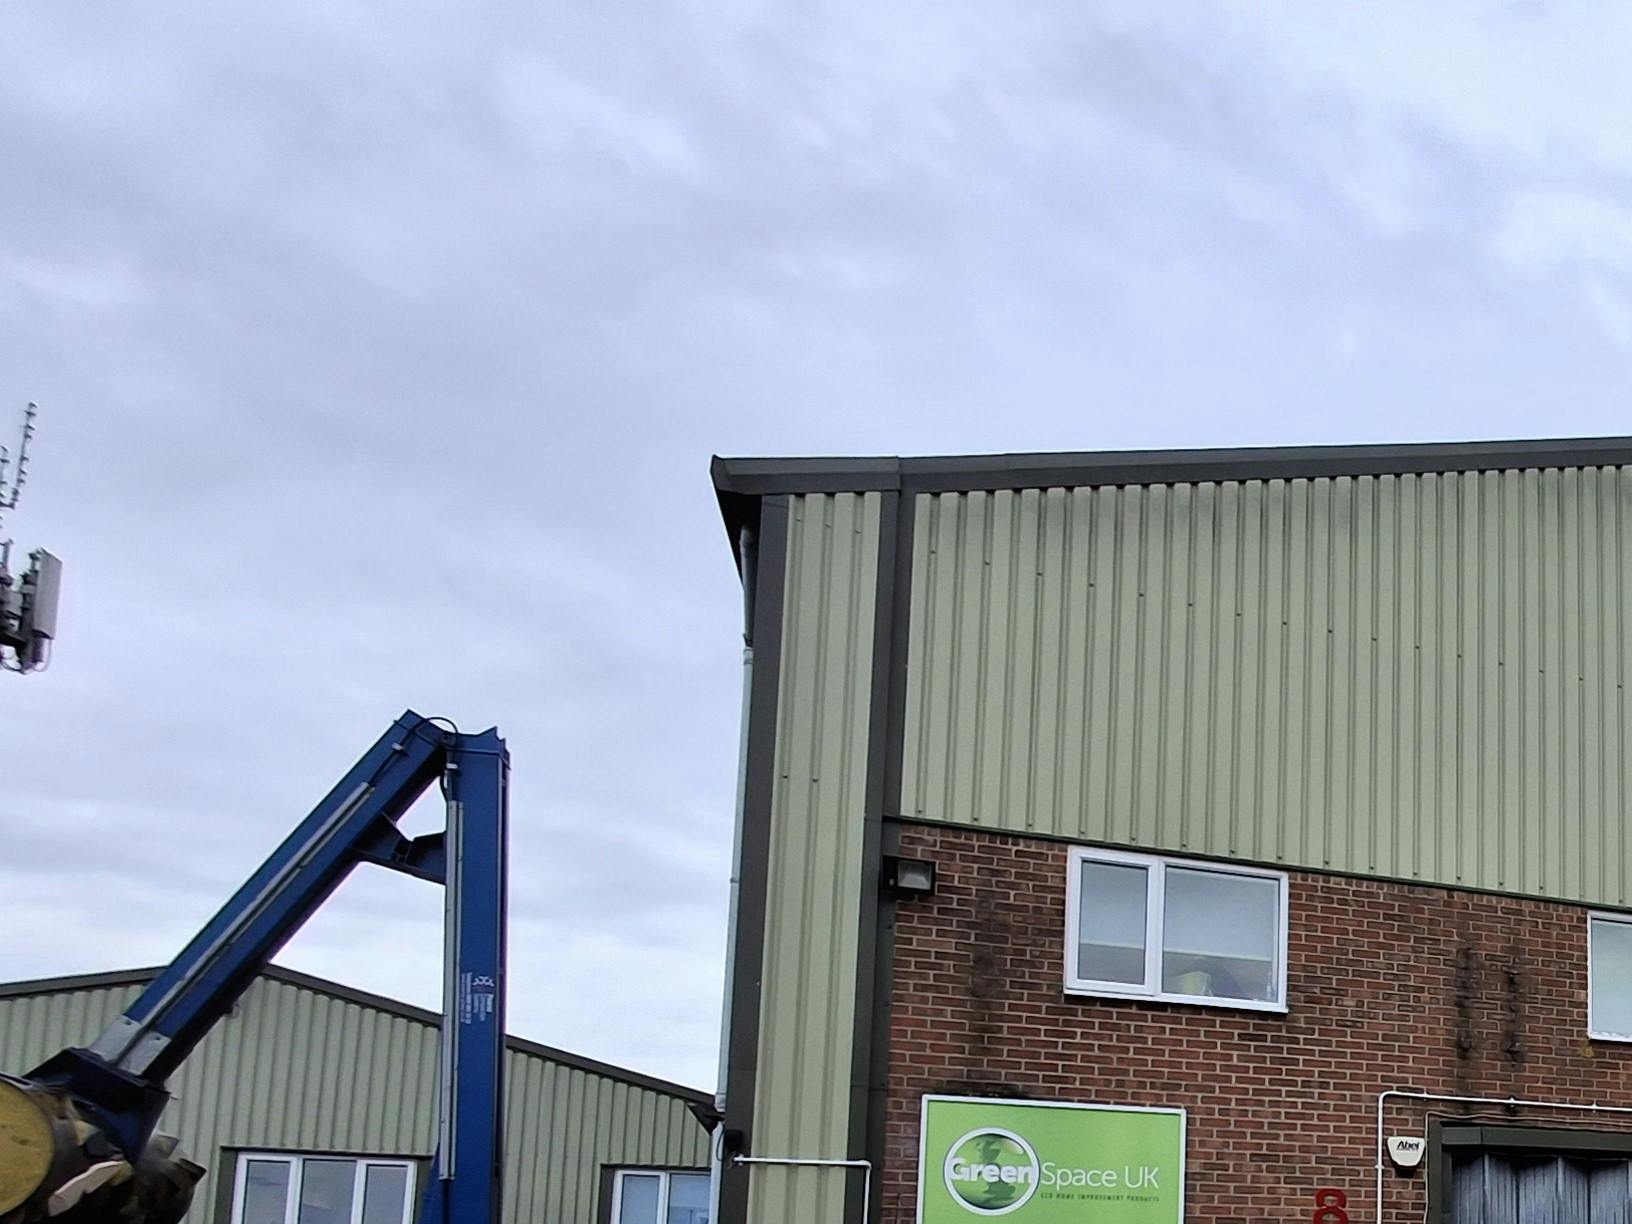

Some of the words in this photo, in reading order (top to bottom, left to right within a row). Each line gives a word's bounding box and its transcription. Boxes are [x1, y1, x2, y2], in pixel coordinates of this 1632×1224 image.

[949, 1157, 1033, 1184] Green
[1040, 1162, 1118, 1191] Space
[1124, 1165, 1160, 1189] UK
